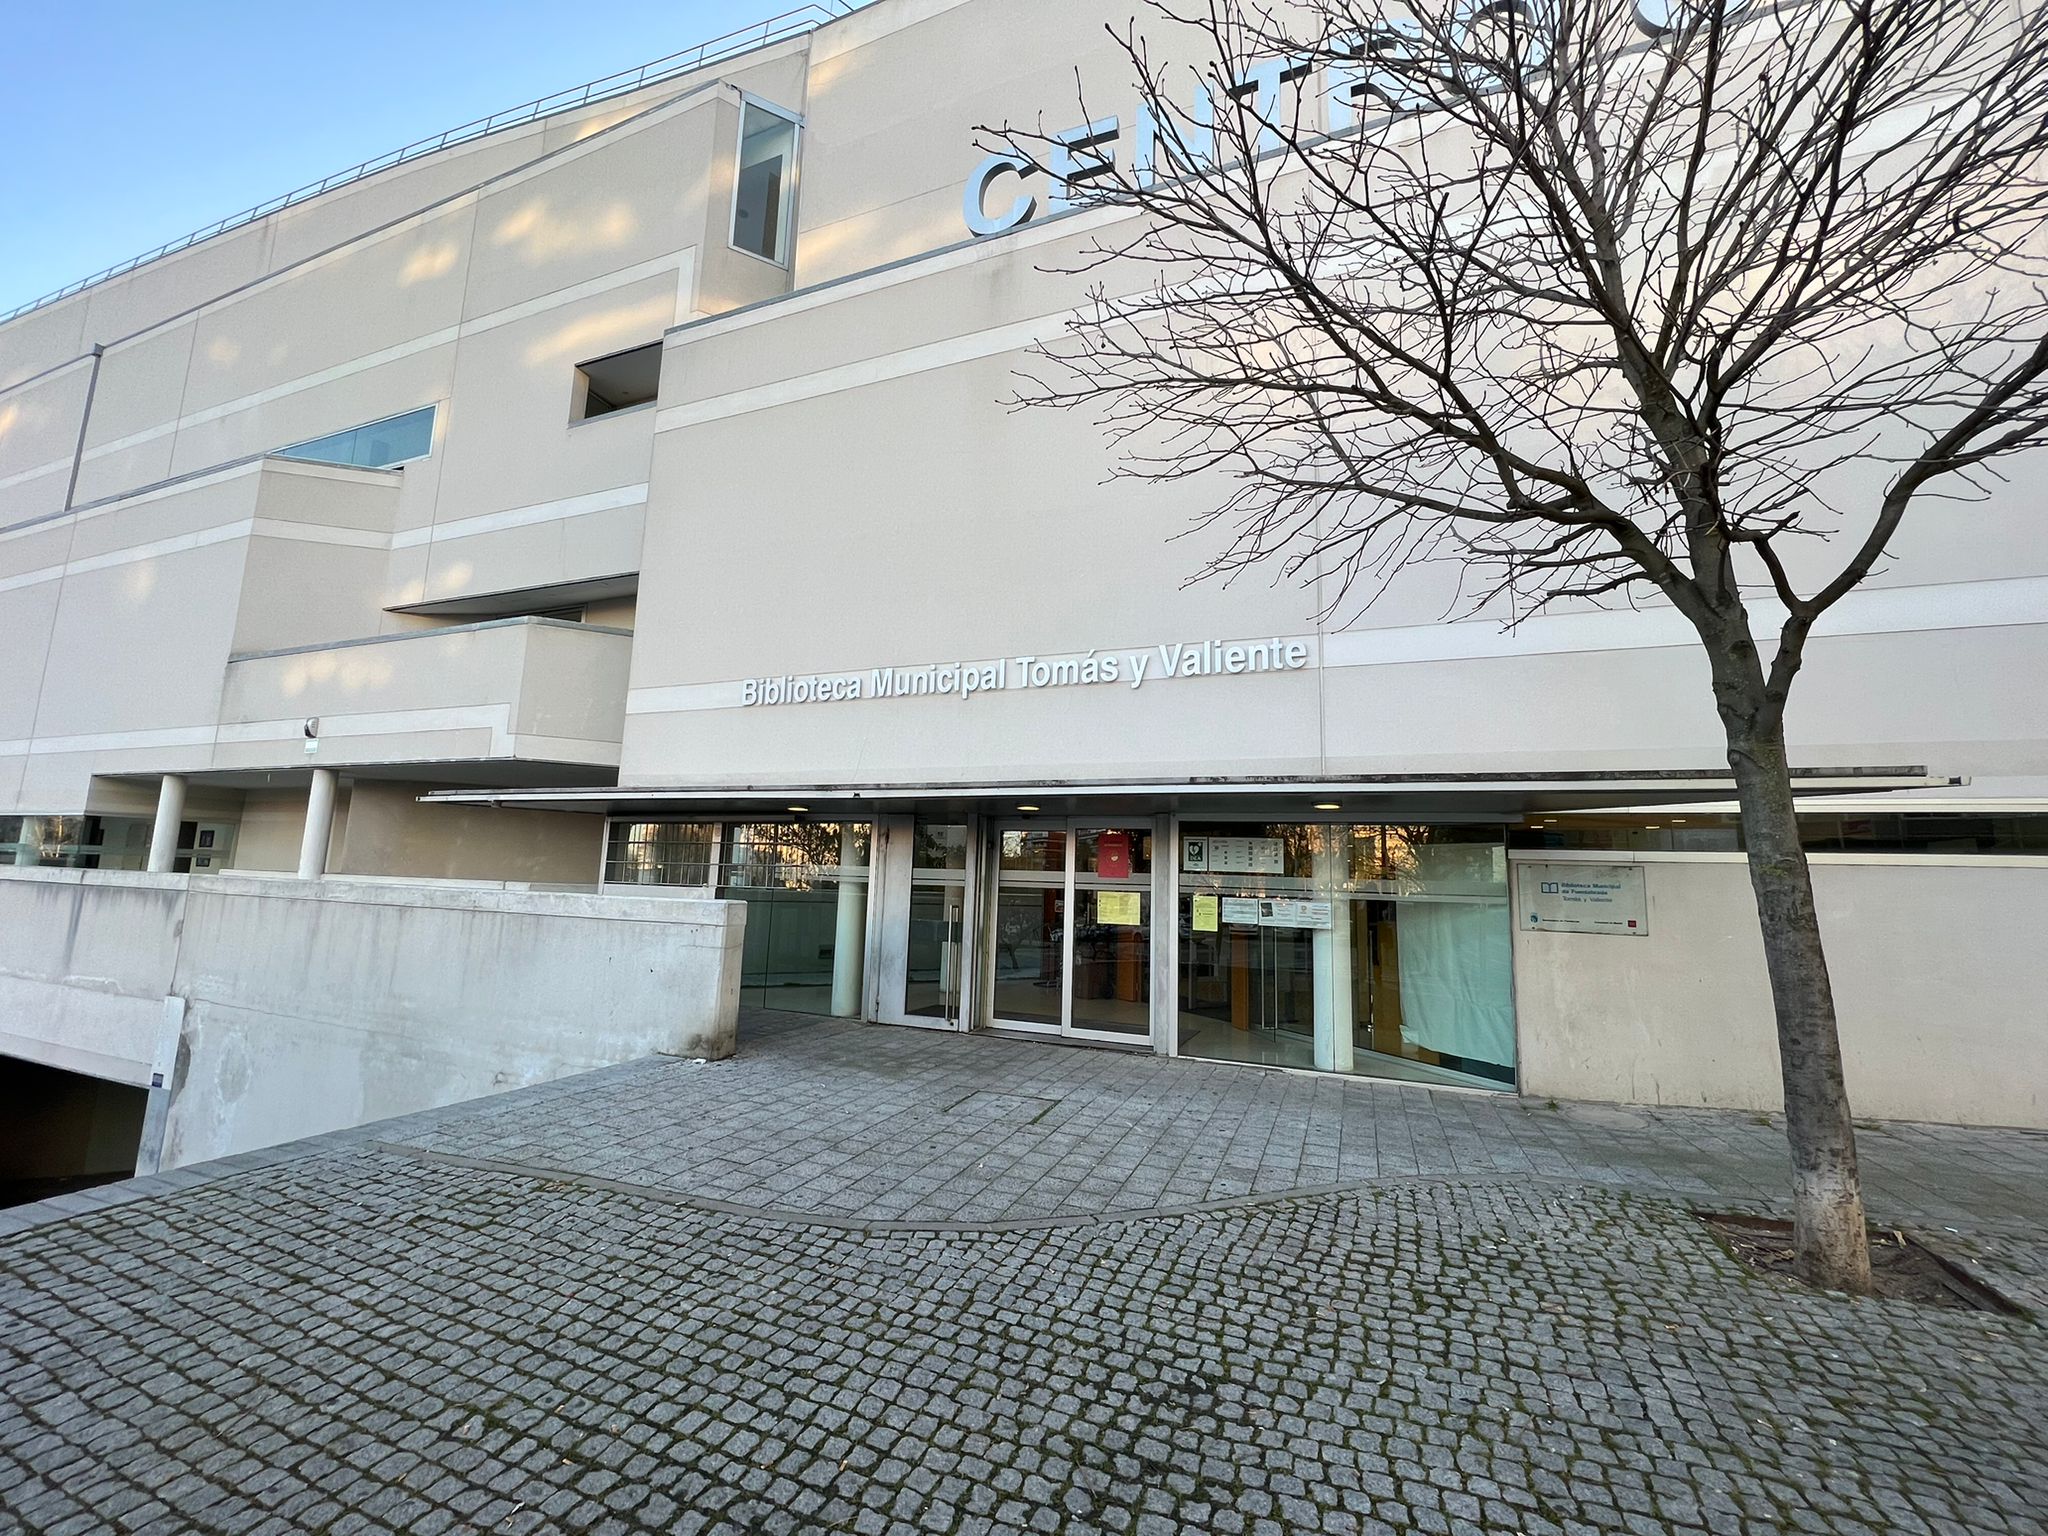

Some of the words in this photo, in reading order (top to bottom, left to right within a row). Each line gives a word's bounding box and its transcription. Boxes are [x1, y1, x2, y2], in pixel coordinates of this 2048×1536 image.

[742, 676, 862, 707] Biblioteca
[870, 658, 1006, 700] Municipal
[1015, 648, 1120, 688] Tomás
[1129, 654, 1150, 689] y
[1158, 637, 1308, 677] Valiente
